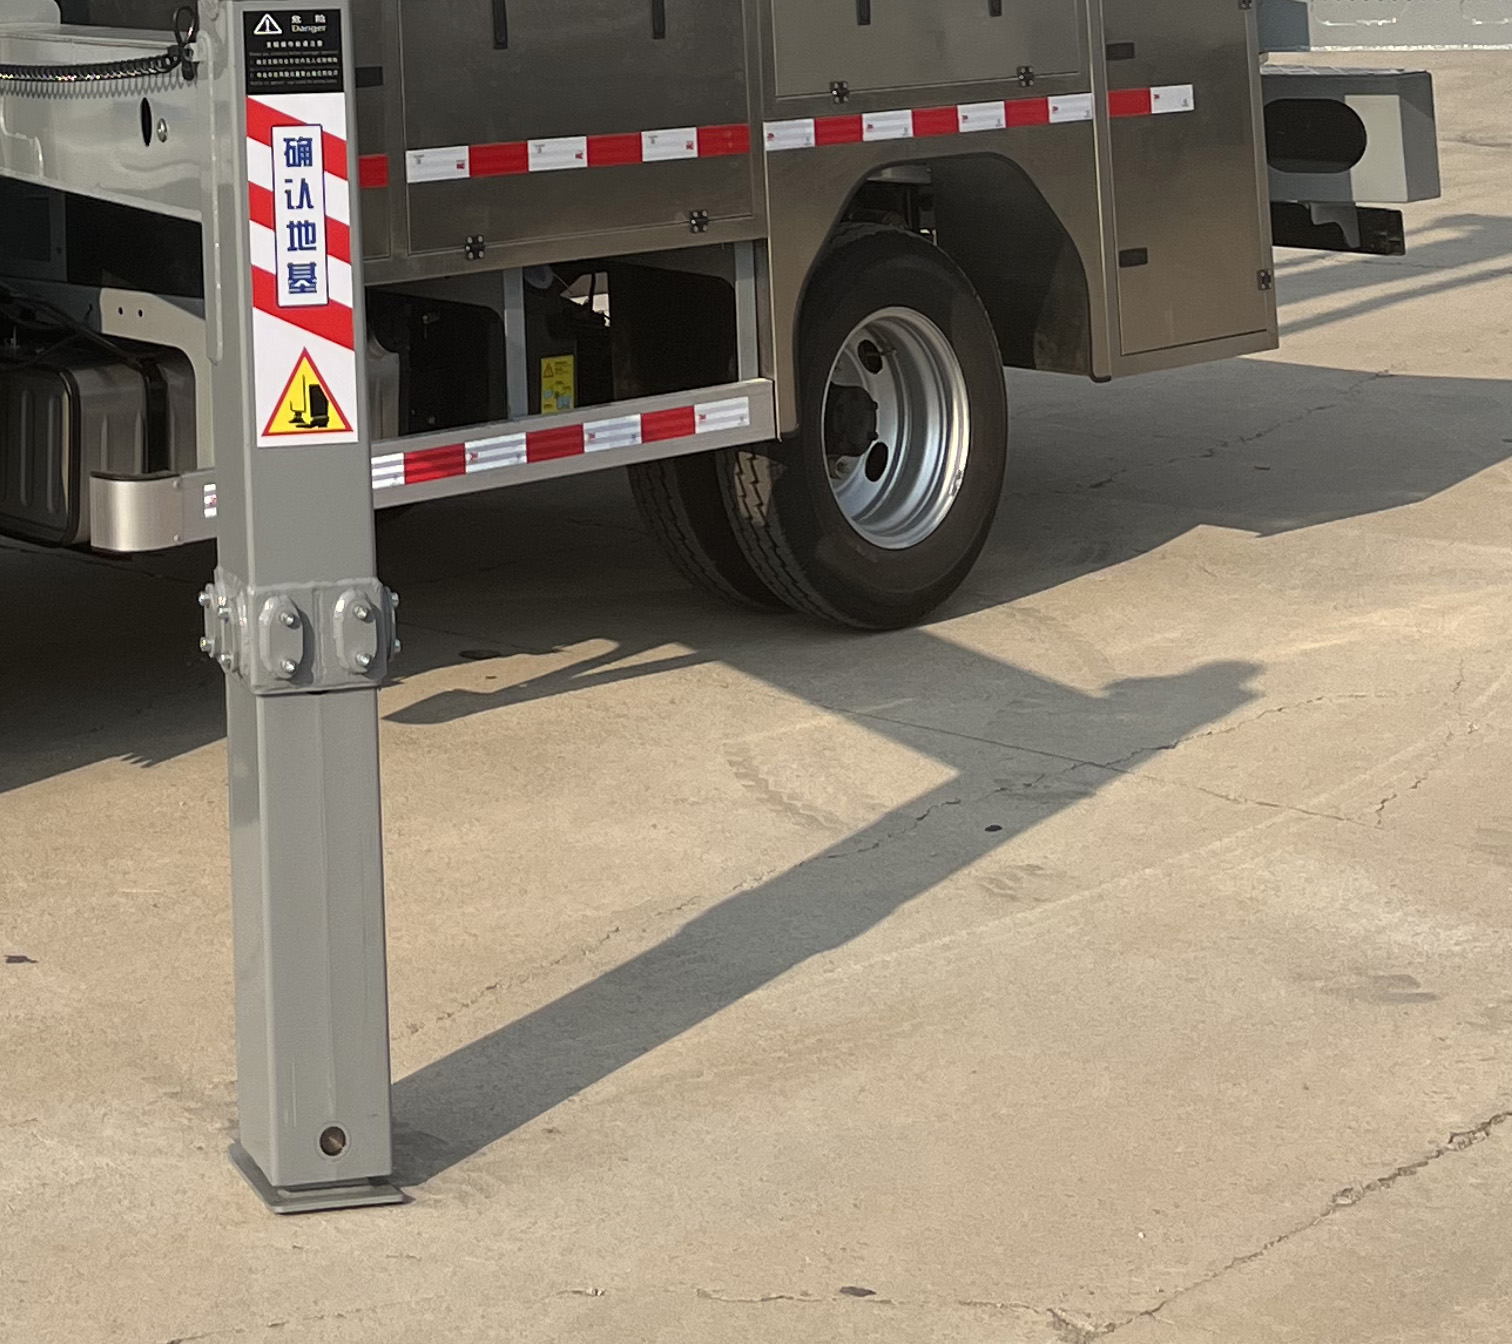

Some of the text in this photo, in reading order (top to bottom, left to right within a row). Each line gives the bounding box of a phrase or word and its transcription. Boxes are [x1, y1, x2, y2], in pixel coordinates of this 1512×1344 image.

[291, 24, 327, 33] Danger
[283, 136, 318, 294] 确认地基
